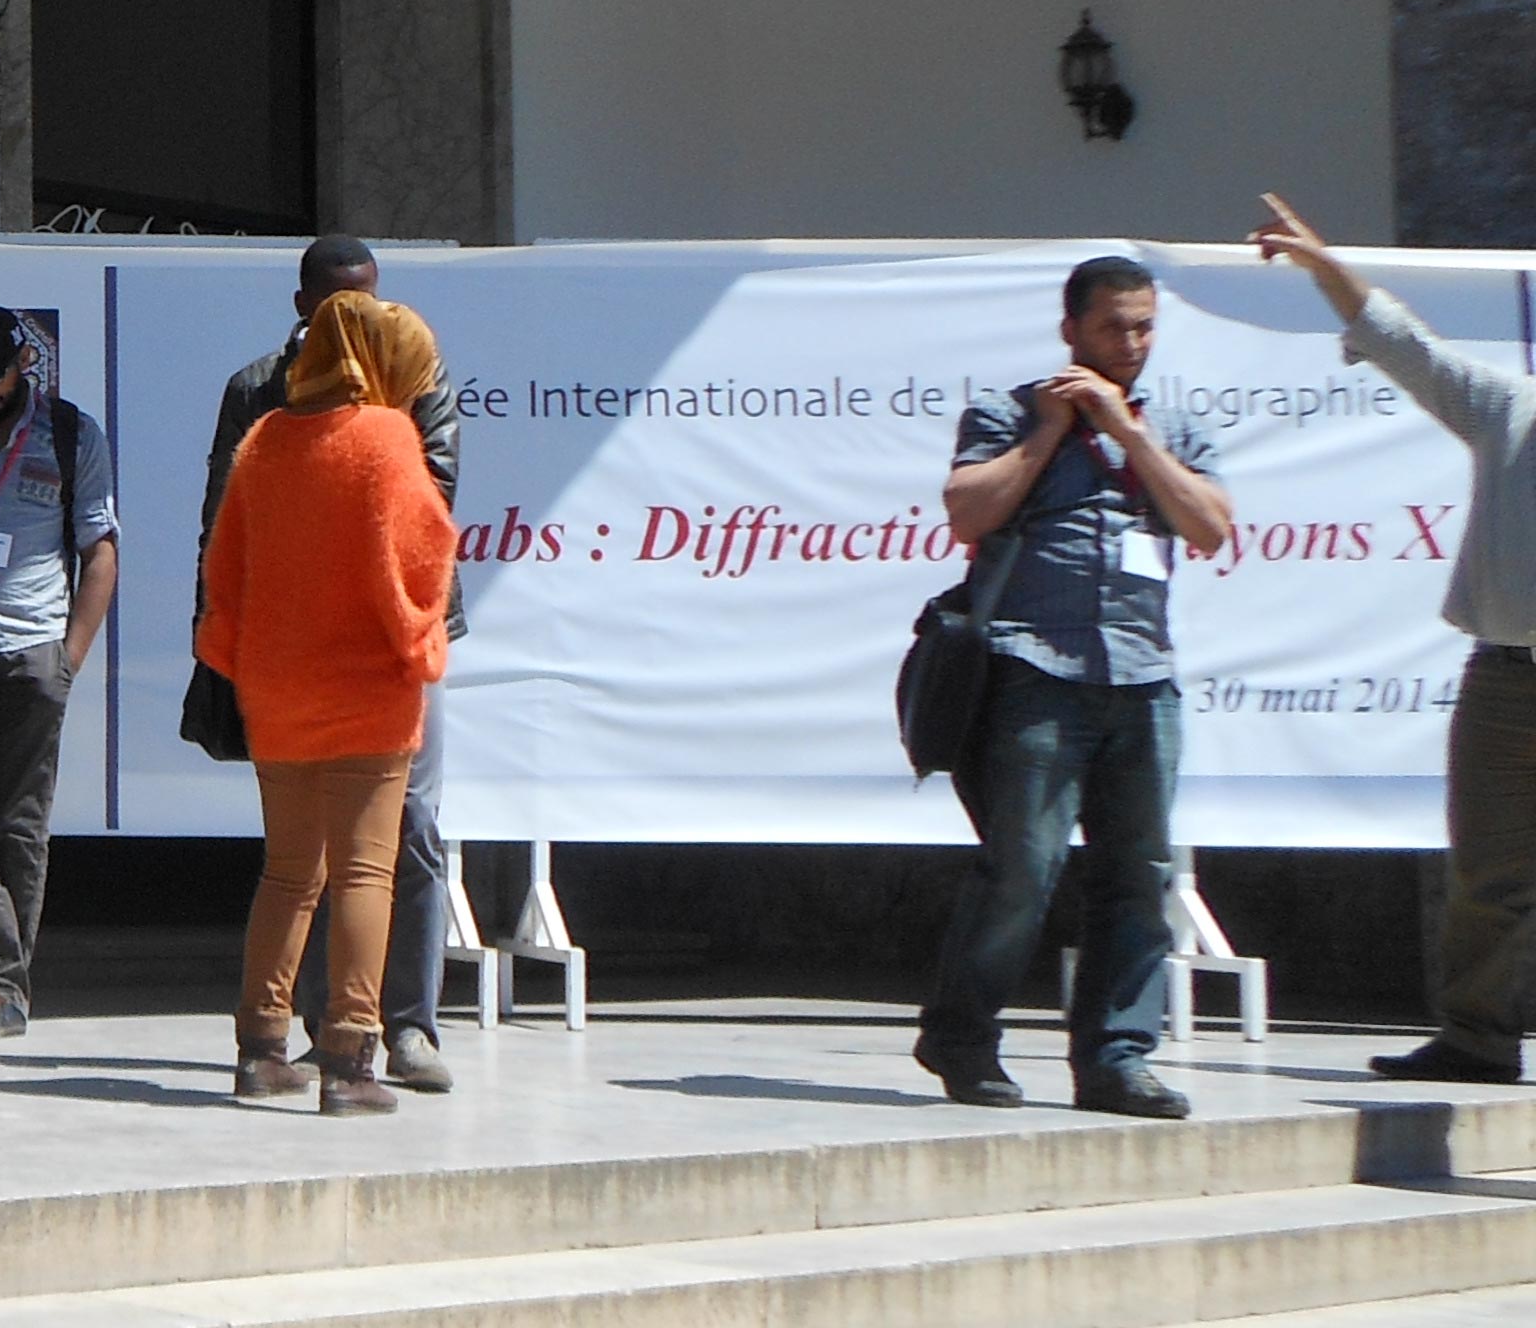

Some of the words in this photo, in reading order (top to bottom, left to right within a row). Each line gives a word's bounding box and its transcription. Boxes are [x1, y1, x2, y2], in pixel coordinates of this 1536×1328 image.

[529, 375, 872, 418] Internationale
[890, 376, 945, 418] de
[1140, 375, 1398, 428] llographie
[1392, 505, 1455, 560] X
[1195, 677, 1244, 713] 30
[1259, 678, 1339, 713] mai
[1353, 676, 1458, 714] 2014
